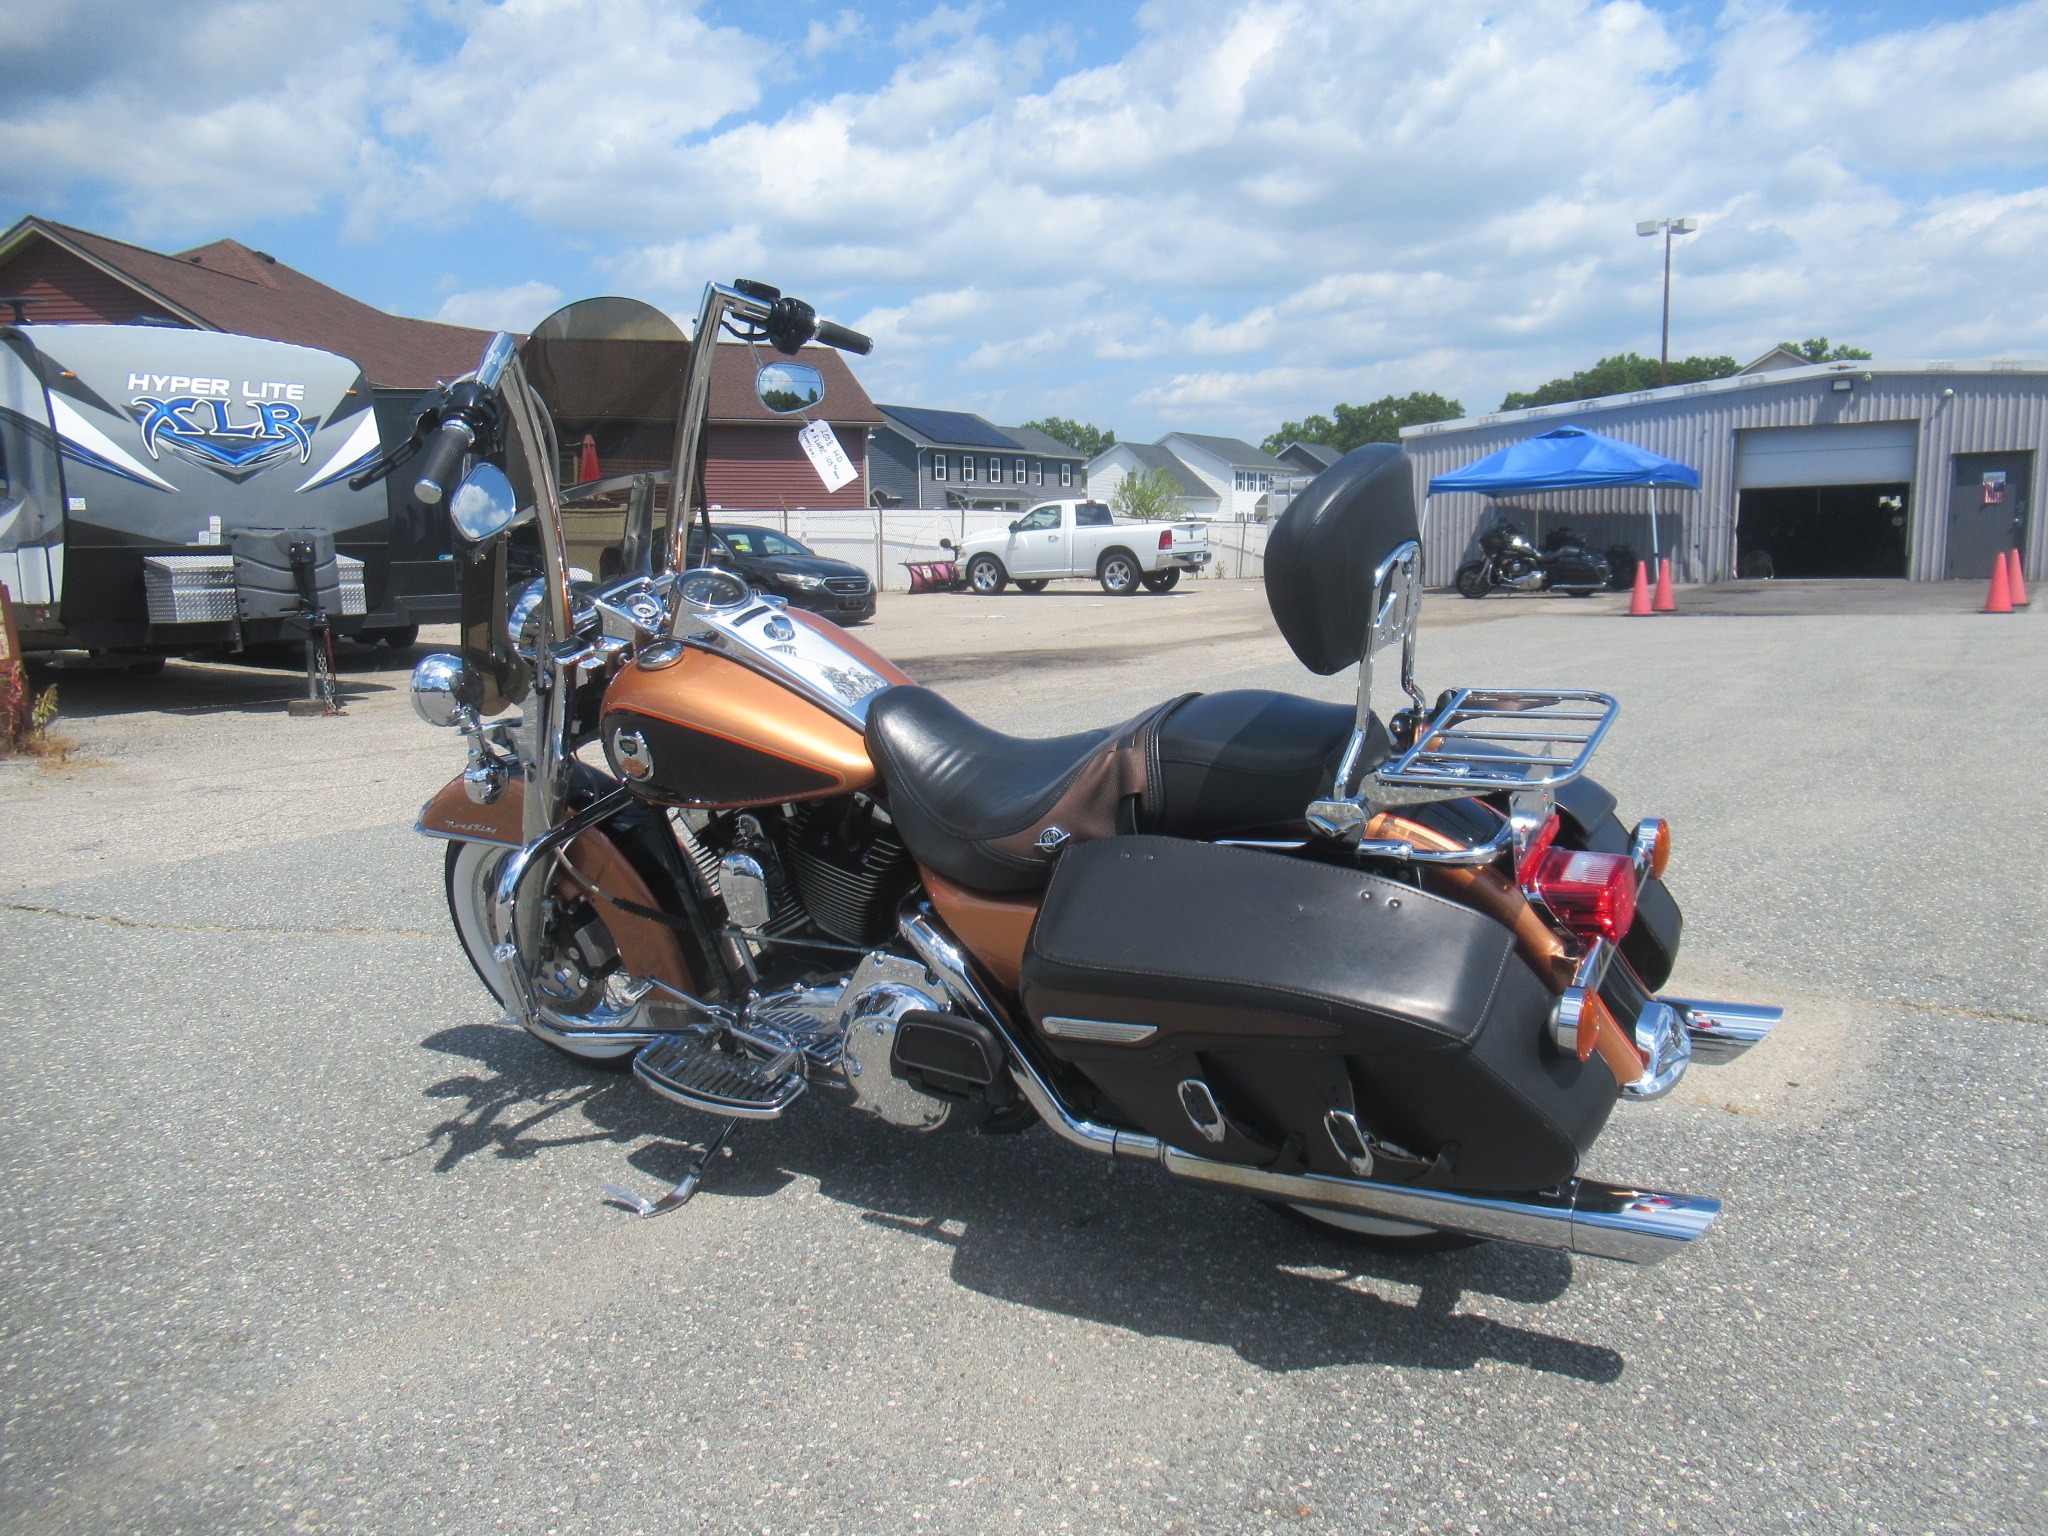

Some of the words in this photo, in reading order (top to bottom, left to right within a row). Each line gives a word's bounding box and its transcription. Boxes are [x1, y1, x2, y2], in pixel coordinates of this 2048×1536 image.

[127, 373, 230, 396] HYPER
[242, 380, 305, 400] LITE
[131, 395, 312, 464] XLR
[820, 429, 834, 446] 2008
[832, 449, 843, 463] HD
